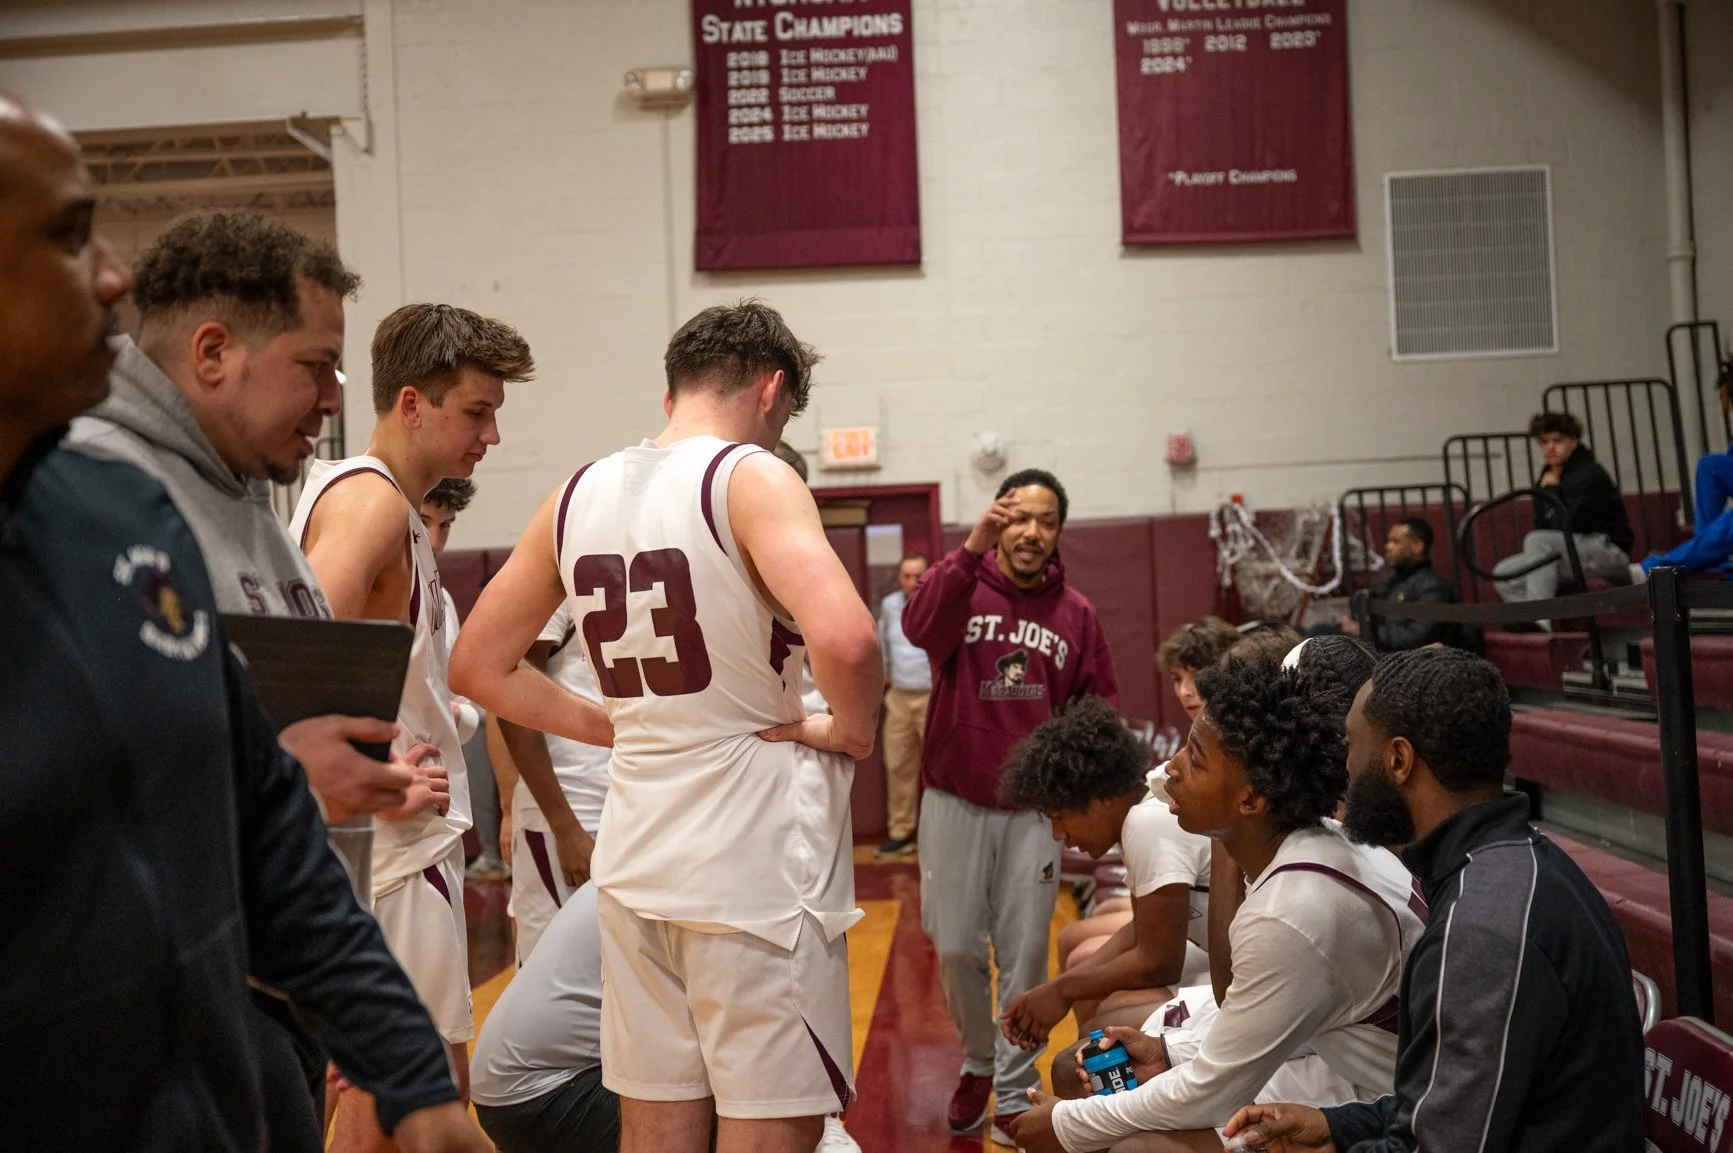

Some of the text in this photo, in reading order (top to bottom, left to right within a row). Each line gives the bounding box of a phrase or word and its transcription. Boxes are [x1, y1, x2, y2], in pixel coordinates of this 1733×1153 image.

[775, 12, 903, 40] CHAMPIONS
[1204, 34, 1247, 52] 2012
[728, 106, 774, 125] 2024
[728, 124, 775, 144] 2025
[573, 547, 712, 698] 23
[964, 614, 1069, 671] ST. JOE'S
[1671, 1068, 1731, 1153] JOE'S
